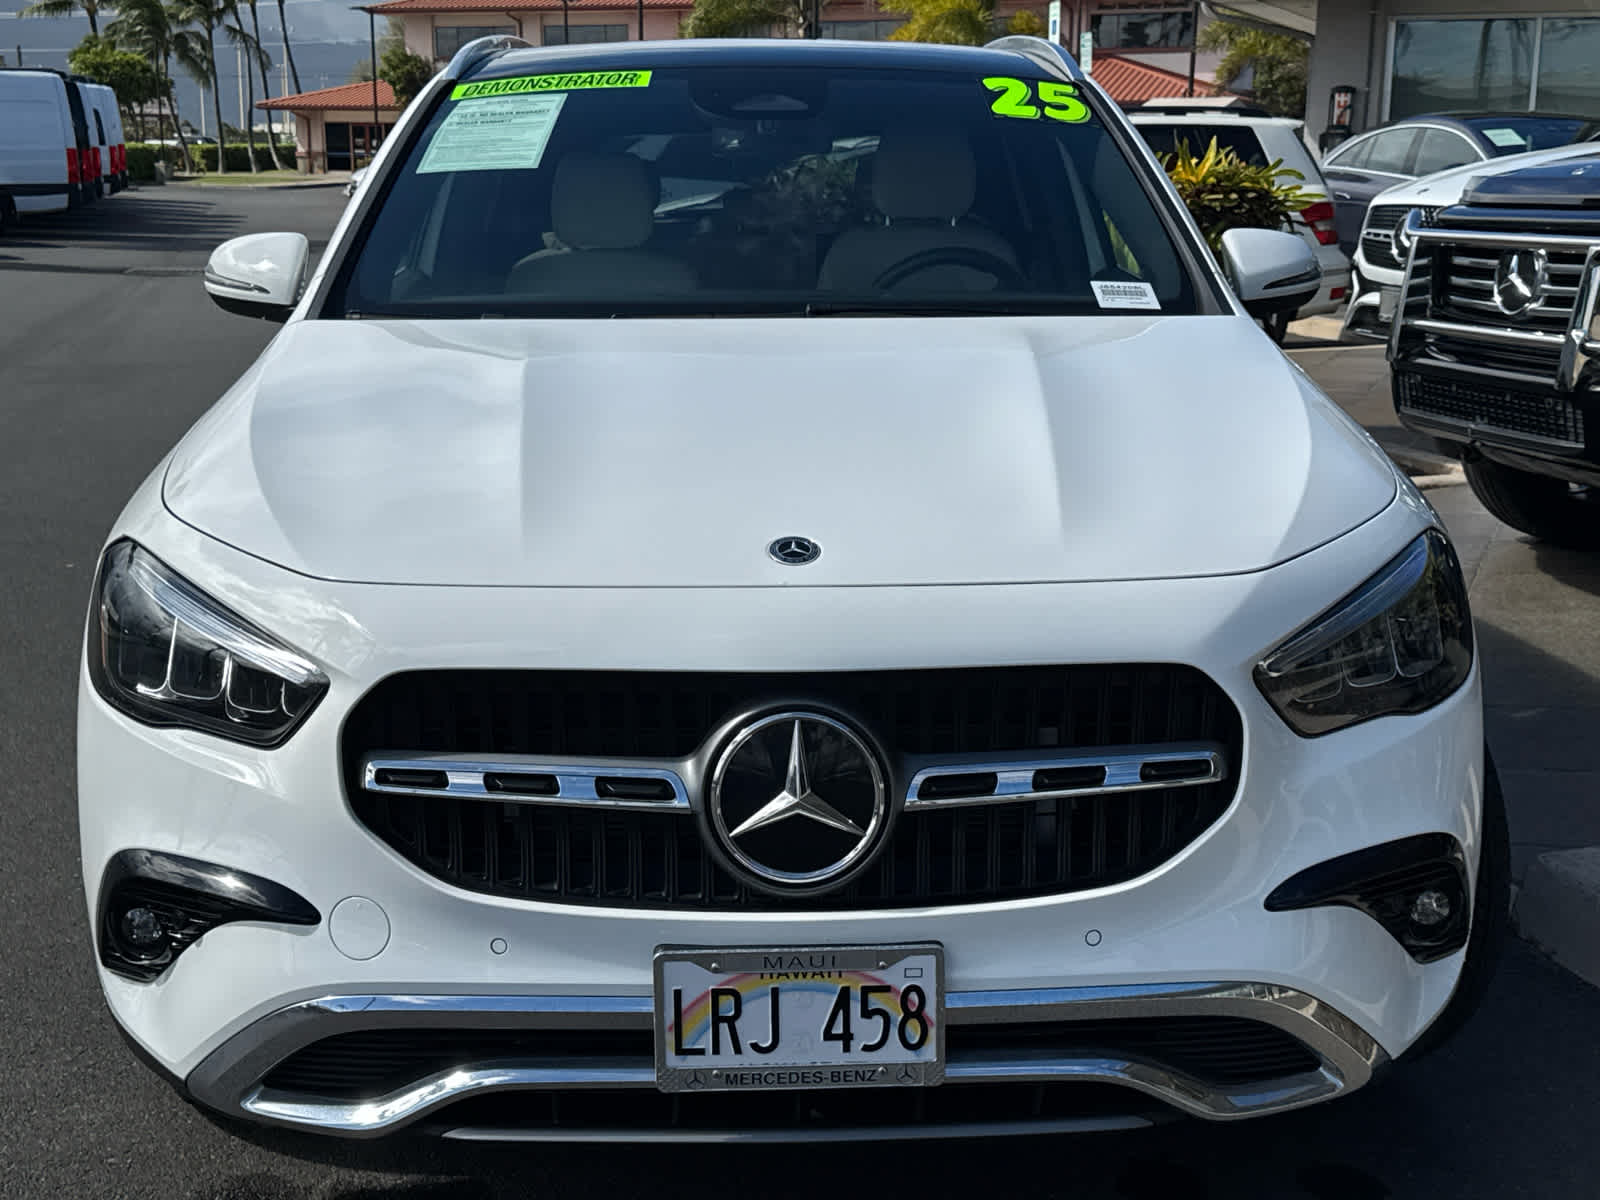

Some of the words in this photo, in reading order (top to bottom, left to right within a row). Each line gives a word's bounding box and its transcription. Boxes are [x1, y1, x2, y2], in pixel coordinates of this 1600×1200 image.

[461, 72, 640, 97] DEMONSTRATOR
[982, 77, 1091, 123] 25
[763, 955, 836, 969] MAUI
[673, 986, 780, 1056] LRJ
[822, 984, 929, 1053] 458
[725, 1069, 877, 1086] MERCEDES-BENZ
